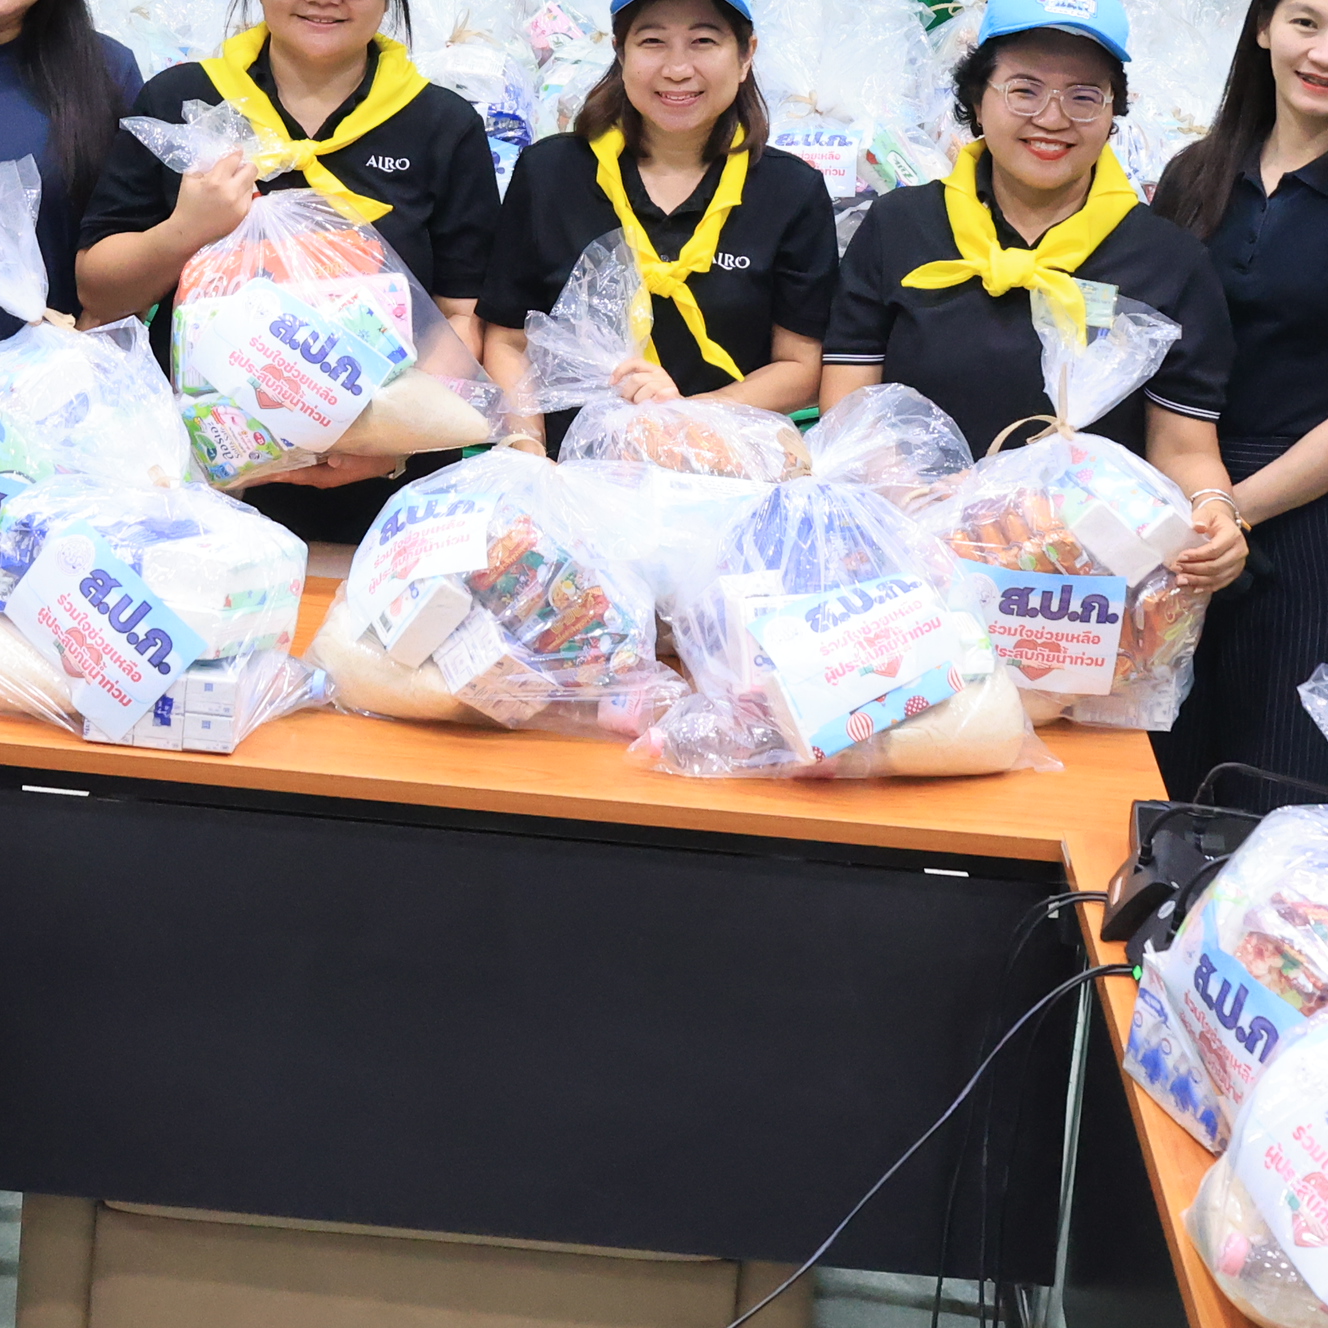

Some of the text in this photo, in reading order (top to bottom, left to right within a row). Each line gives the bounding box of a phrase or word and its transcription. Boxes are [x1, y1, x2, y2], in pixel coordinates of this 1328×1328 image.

[365, 154, 410, 173] ALRO
[774, 131, 853, 147] ส.ป.ก.
[228, 349, 332, 429] ผู้ประสบภัยน้ำท่วม
[248, 334, 338, 407] ร่วมใจช่วยเหลือ
[269, 313, 363, 398] ส.ป.ก.
[379, 498, 484, 547] ส.ป.ก.
[57, 592, 142, 684] ร่วมใจช่วยเหลือ
[79, 566, 172, 675] ส.ป.ก.
[988, 621, 1102, 645] ร่วมใจช่วยเหลือ
[999, 584, 1120, 624] ส.ป.ก.
[37, 606, 133, 708] ผู้ประสบภัยน้ำท่วม
